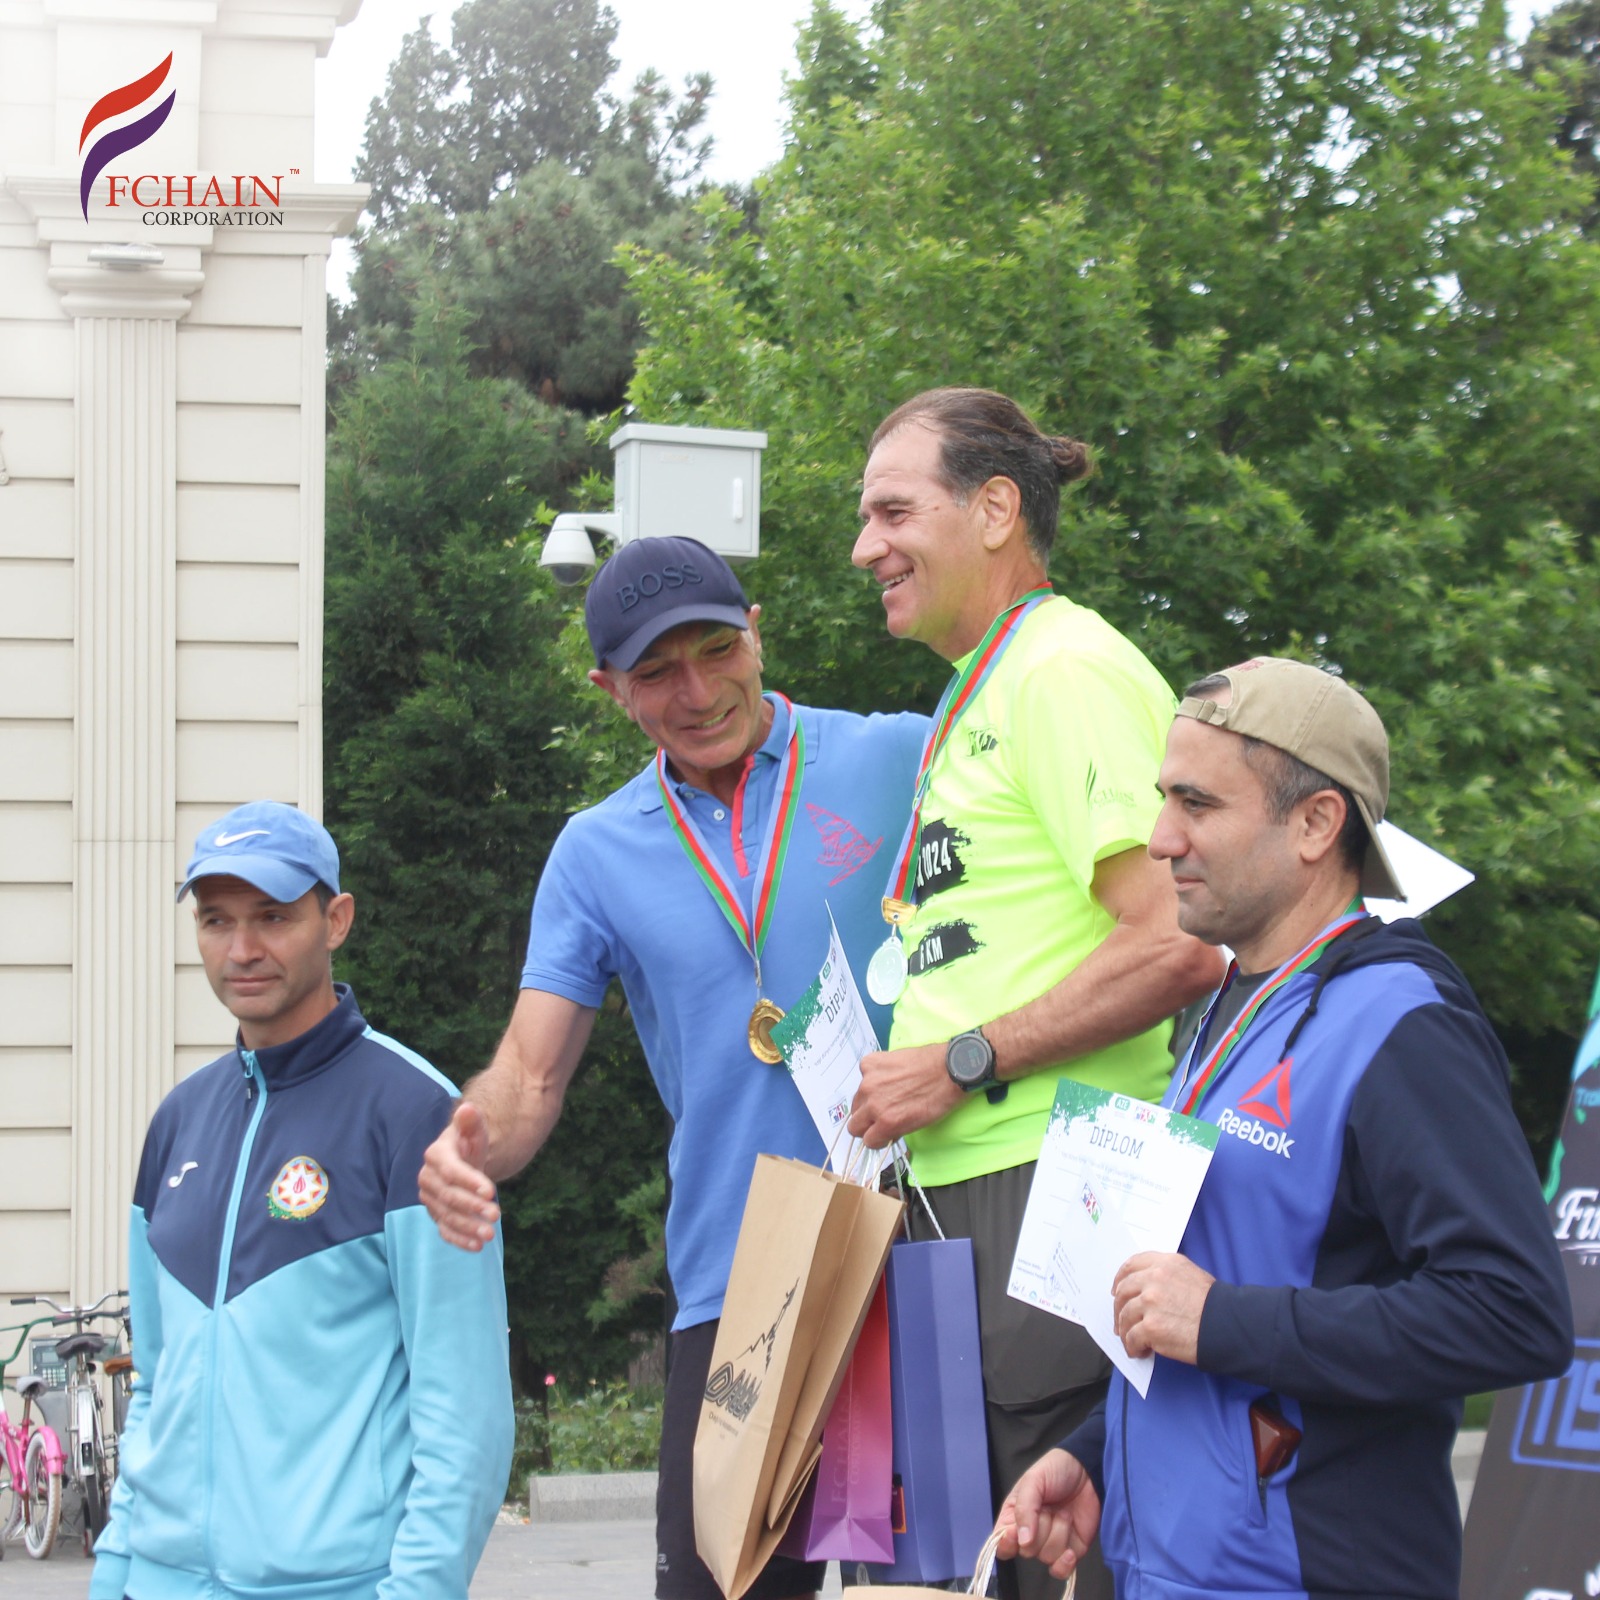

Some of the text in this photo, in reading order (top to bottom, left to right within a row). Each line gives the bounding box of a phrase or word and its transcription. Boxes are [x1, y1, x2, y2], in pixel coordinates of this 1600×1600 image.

[616, 564, 704, 615] BOSS
[925, 935, 944, 965] KM
[1216, 1108, 1296, 1159] Reebok
